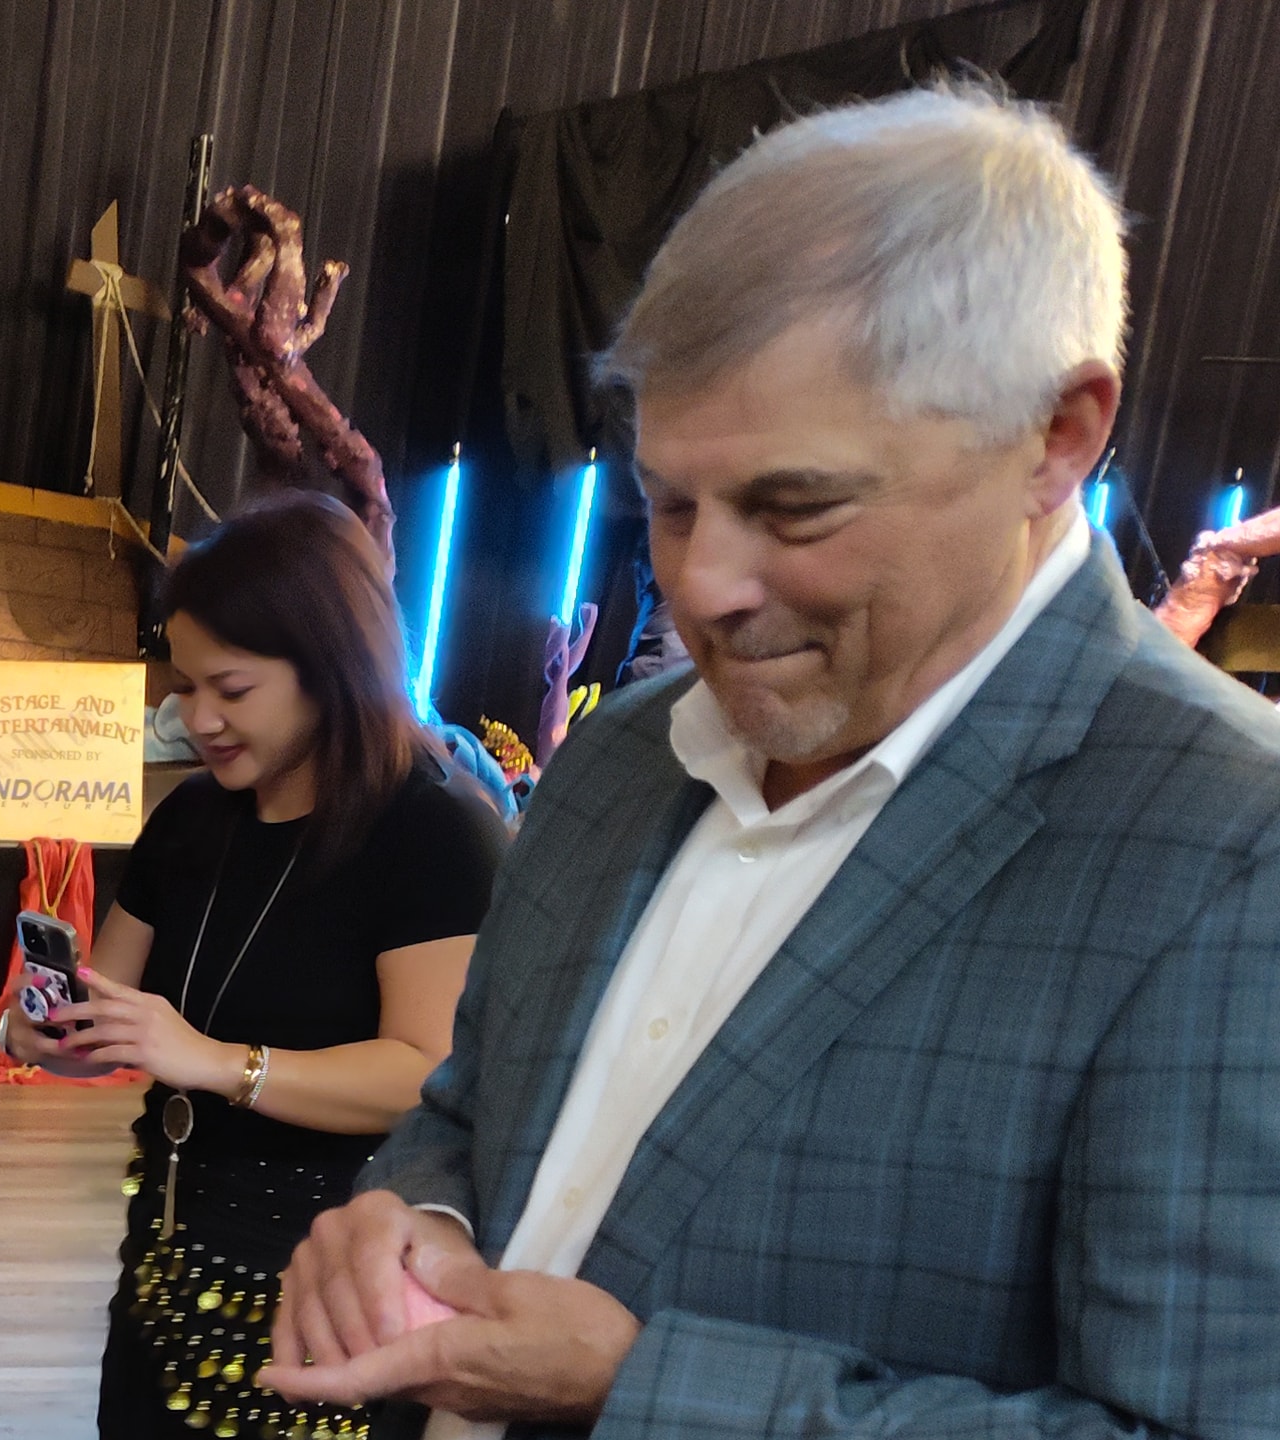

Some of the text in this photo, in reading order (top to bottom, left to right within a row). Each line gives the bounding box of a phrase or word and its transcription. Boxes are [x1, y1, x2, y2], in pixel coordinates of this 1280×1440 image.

[0, 694, 116, 717] STAGE AND
[11, 749, 102, 761] SPONSORED BY
